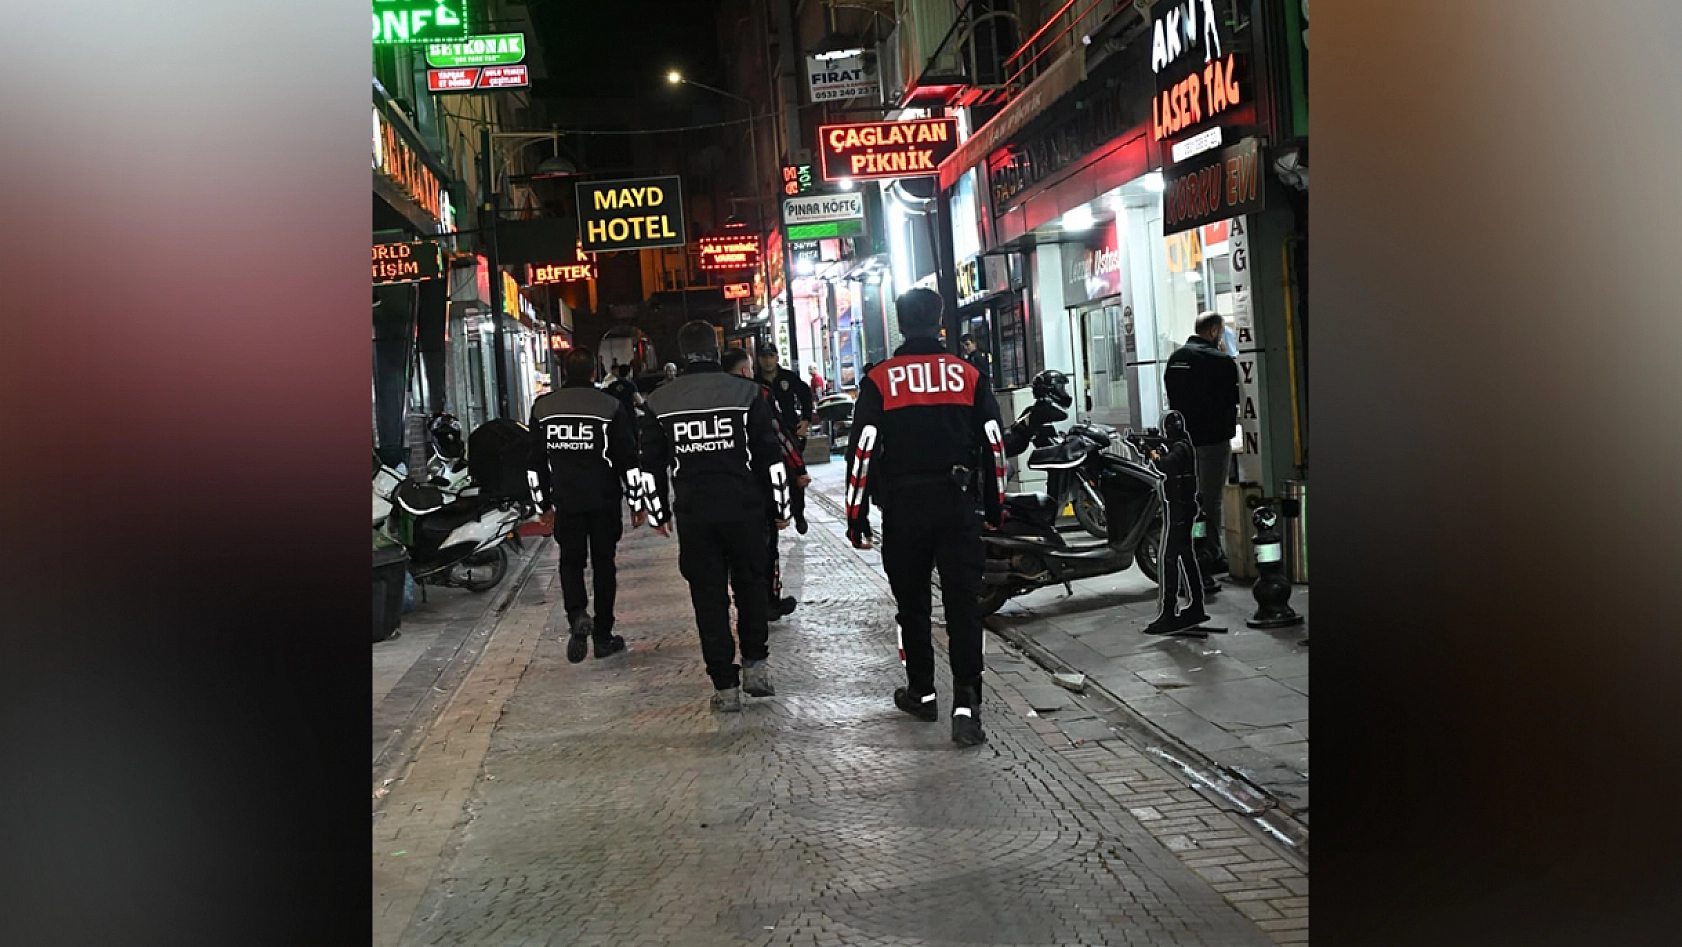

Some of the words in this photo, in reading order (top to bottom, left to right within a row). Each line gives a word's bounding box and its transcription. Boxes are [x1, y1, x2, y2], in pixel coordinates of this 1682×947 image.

[812, 69, 862, 84] FIRAT
[815, 91, 837, 99] 0532
[840, 89, 855, 97] 240
[858, 87, 869, 95] 23
[1153, 72, 1201, 142] LASER
[1204, 53, 1239, 117] TAG
[851, 145, 935, 174] PİKNİK
[593, 186, 663, 211] MAYD
[1166, 163, 1221, 226] KORKU
[788, 202, 820, 216] PINAR
[823, 199, 856, 213] KÖFTE
[587, 214, 676, 243] HOTEL
[535, 264, 591, 282] BİFTEK
[888, 358, 965, 397] POLİS
[546, 422, 594, 441] POLİS
[673, 415, 734, 443] POLİS
[546, 441, 594, 451] NARKOTİM
[675, 439, 736, 454] NARKOTİM
